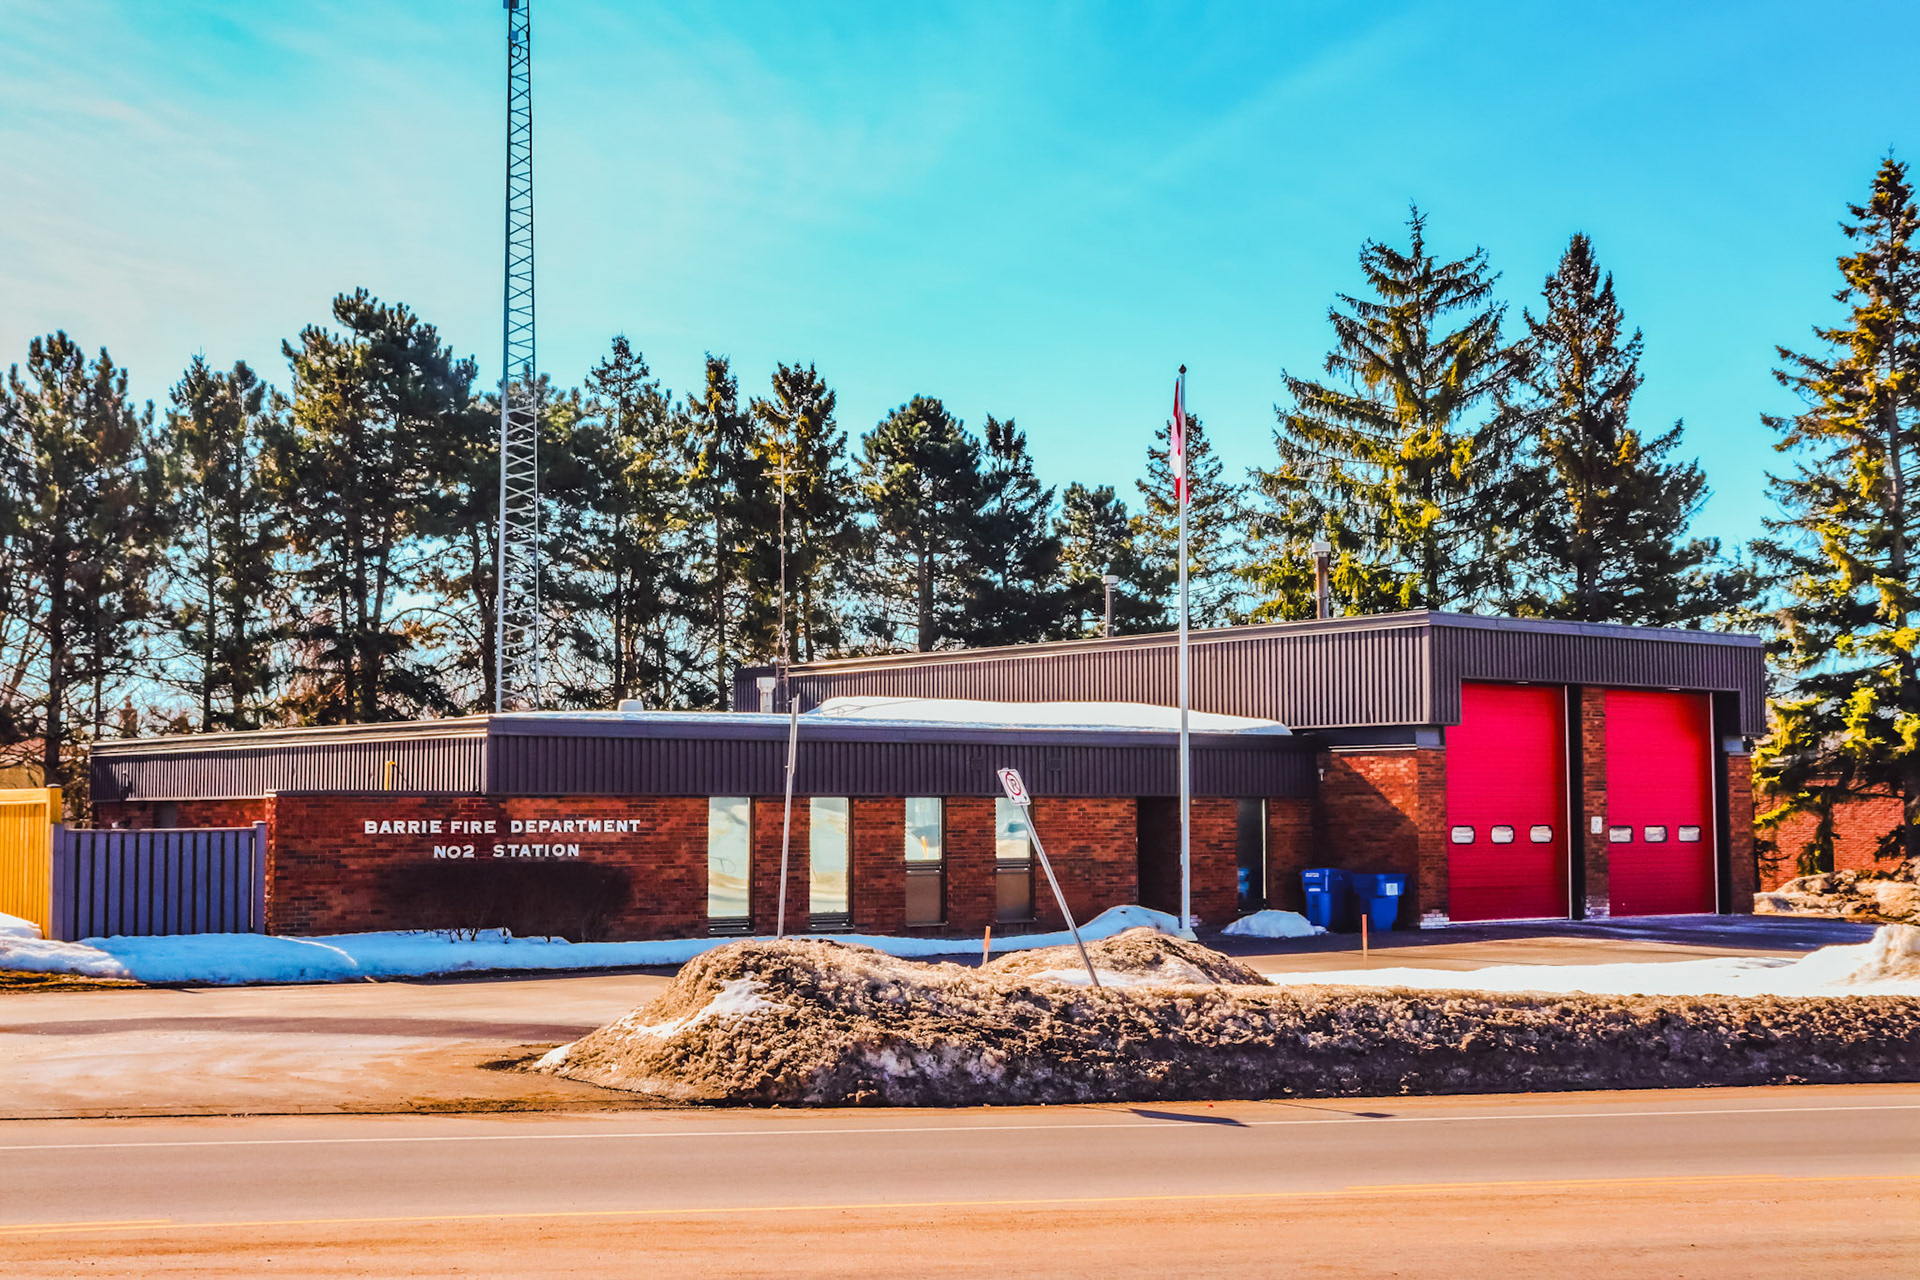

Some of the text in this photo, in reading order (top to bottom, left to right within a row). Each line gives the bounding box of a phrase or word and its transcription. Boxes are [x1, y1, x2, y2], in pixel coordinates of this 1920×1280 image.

[364, 819, 641, 834] BARRIE FIRE DEPARTMENT
[433, 843, 580, 859] NO2 STATION
